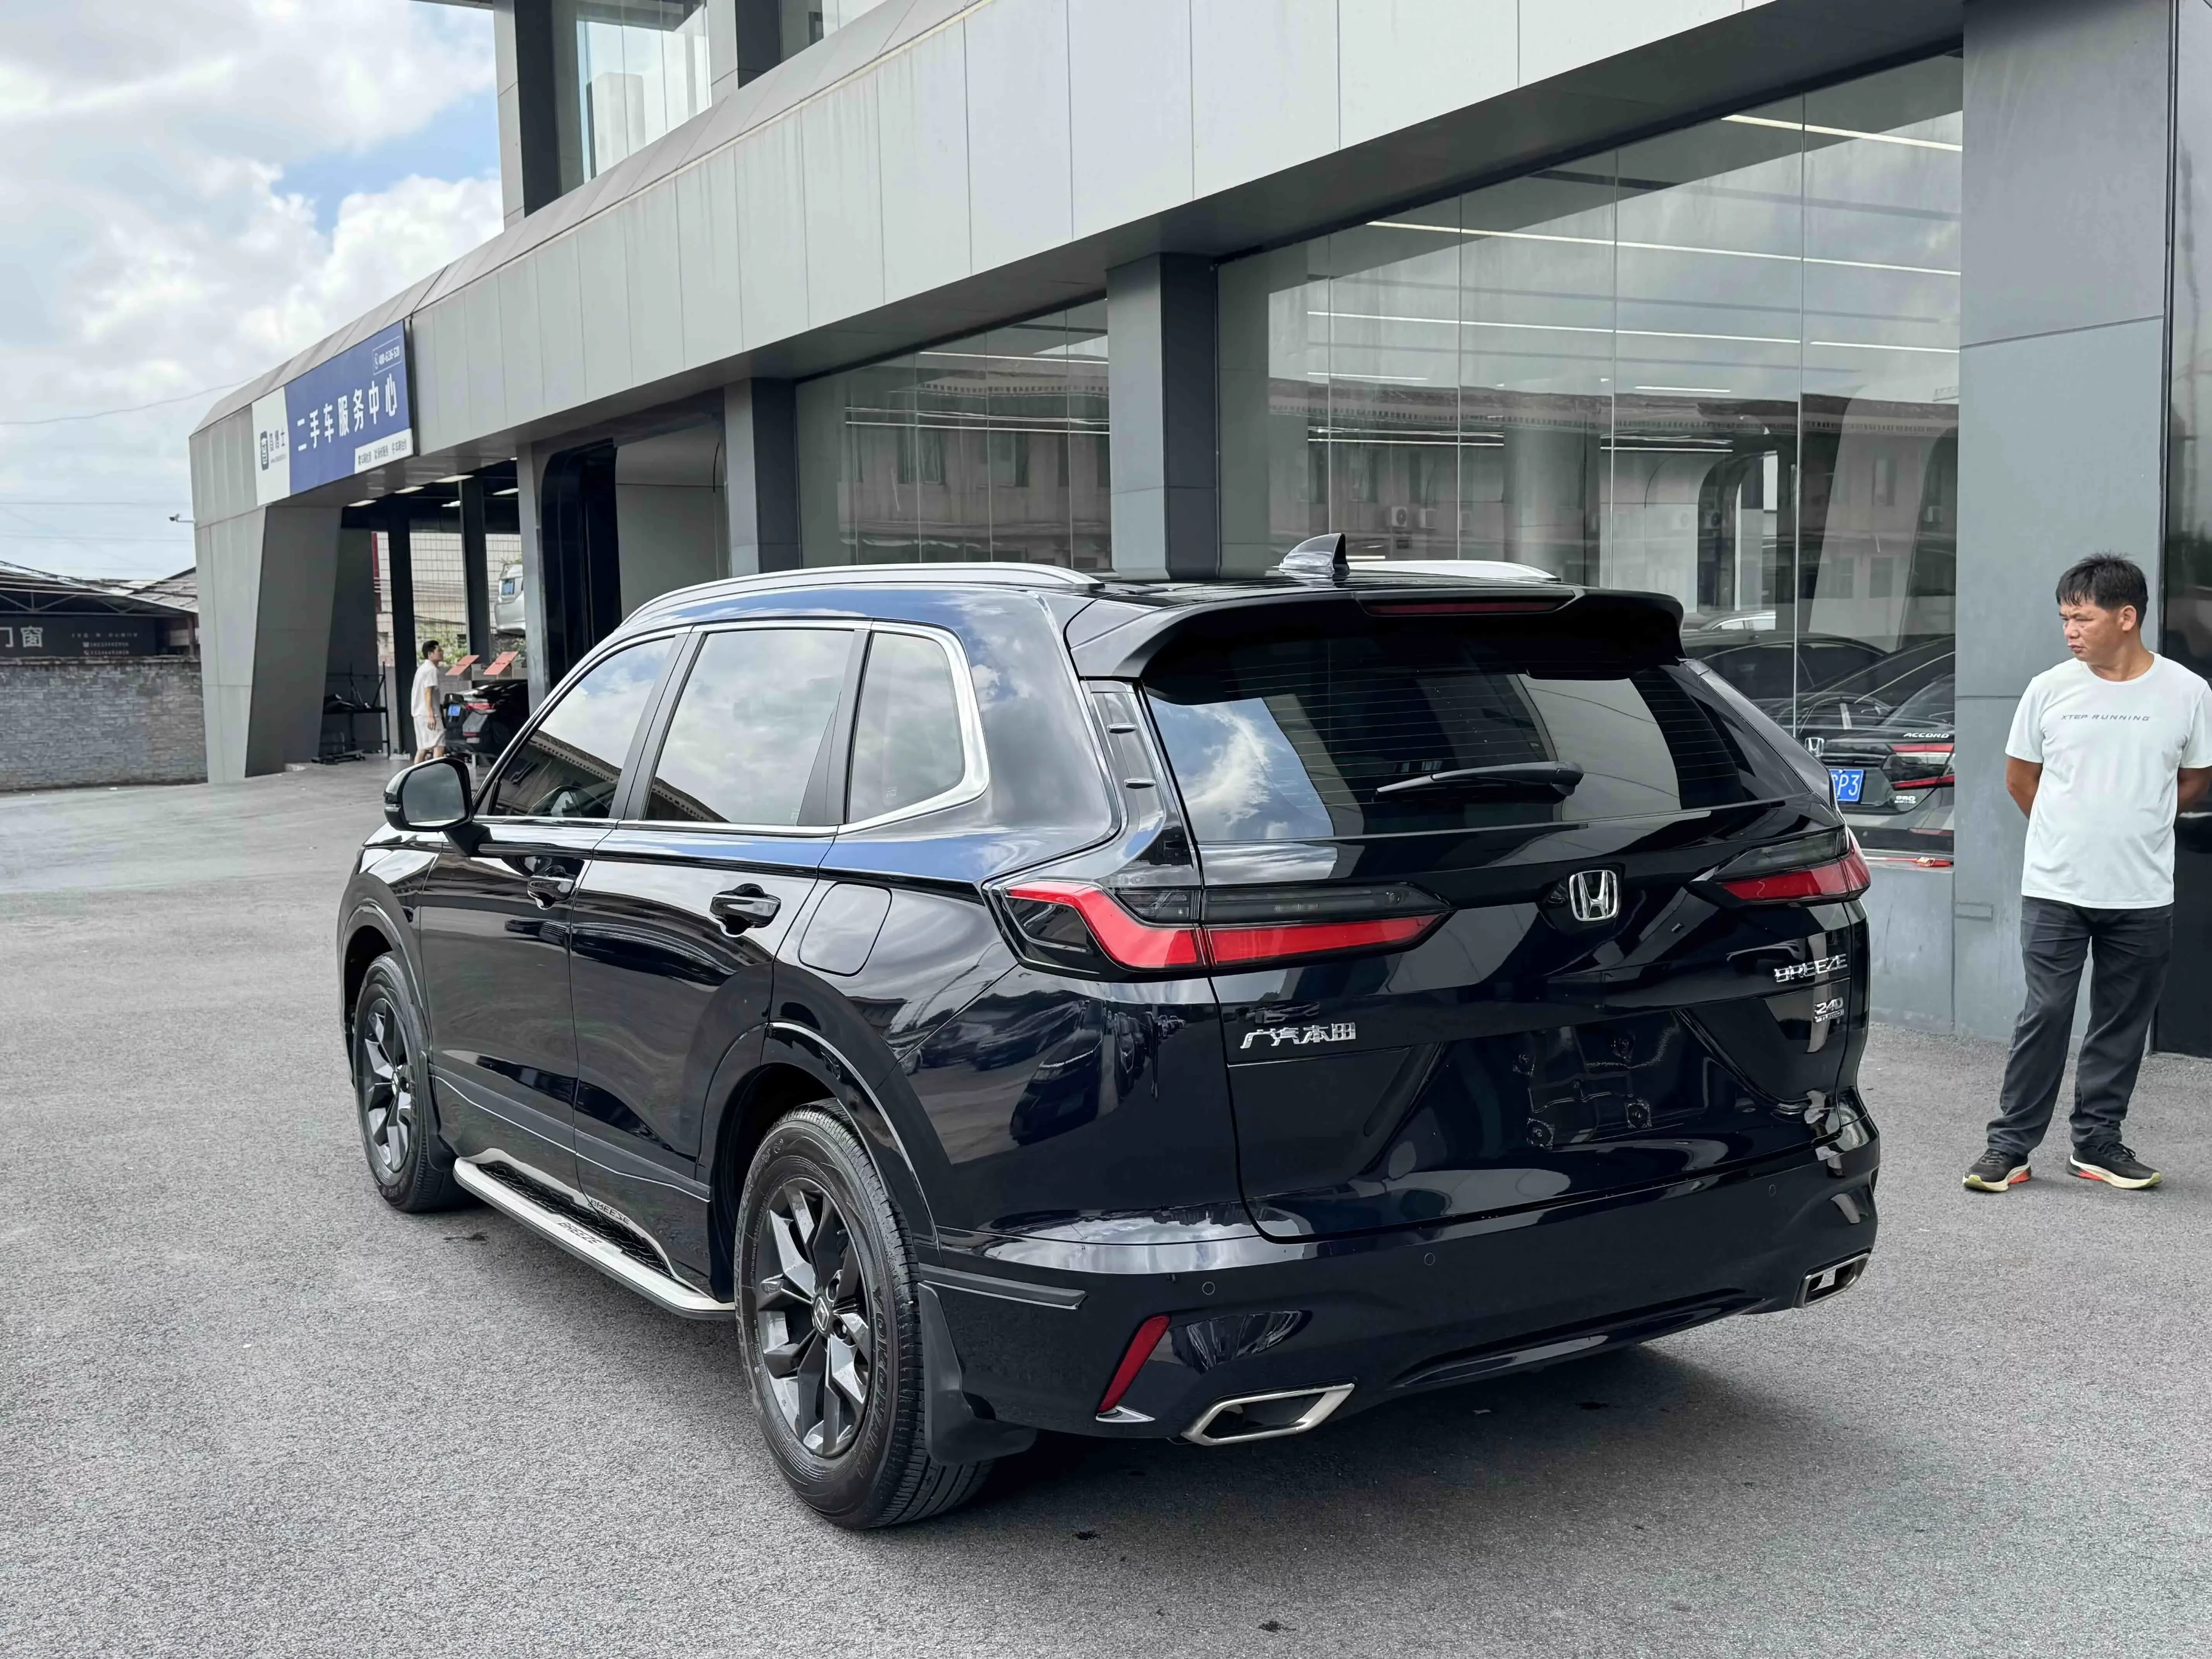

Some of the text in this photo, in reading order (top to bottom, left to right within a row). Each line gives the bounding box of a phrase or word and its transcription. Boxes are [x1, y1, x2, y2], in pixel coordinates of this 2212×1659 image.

[297, 373, 398, 452] 二手车服务中心
[1773, 953, 1848, 982] BREEZE
[1814, 997, 1844, 1014] 240
[1240, 1022, 1356, 1049] 广汽本田
[557, 1222, 603, 1244] BREEZE
